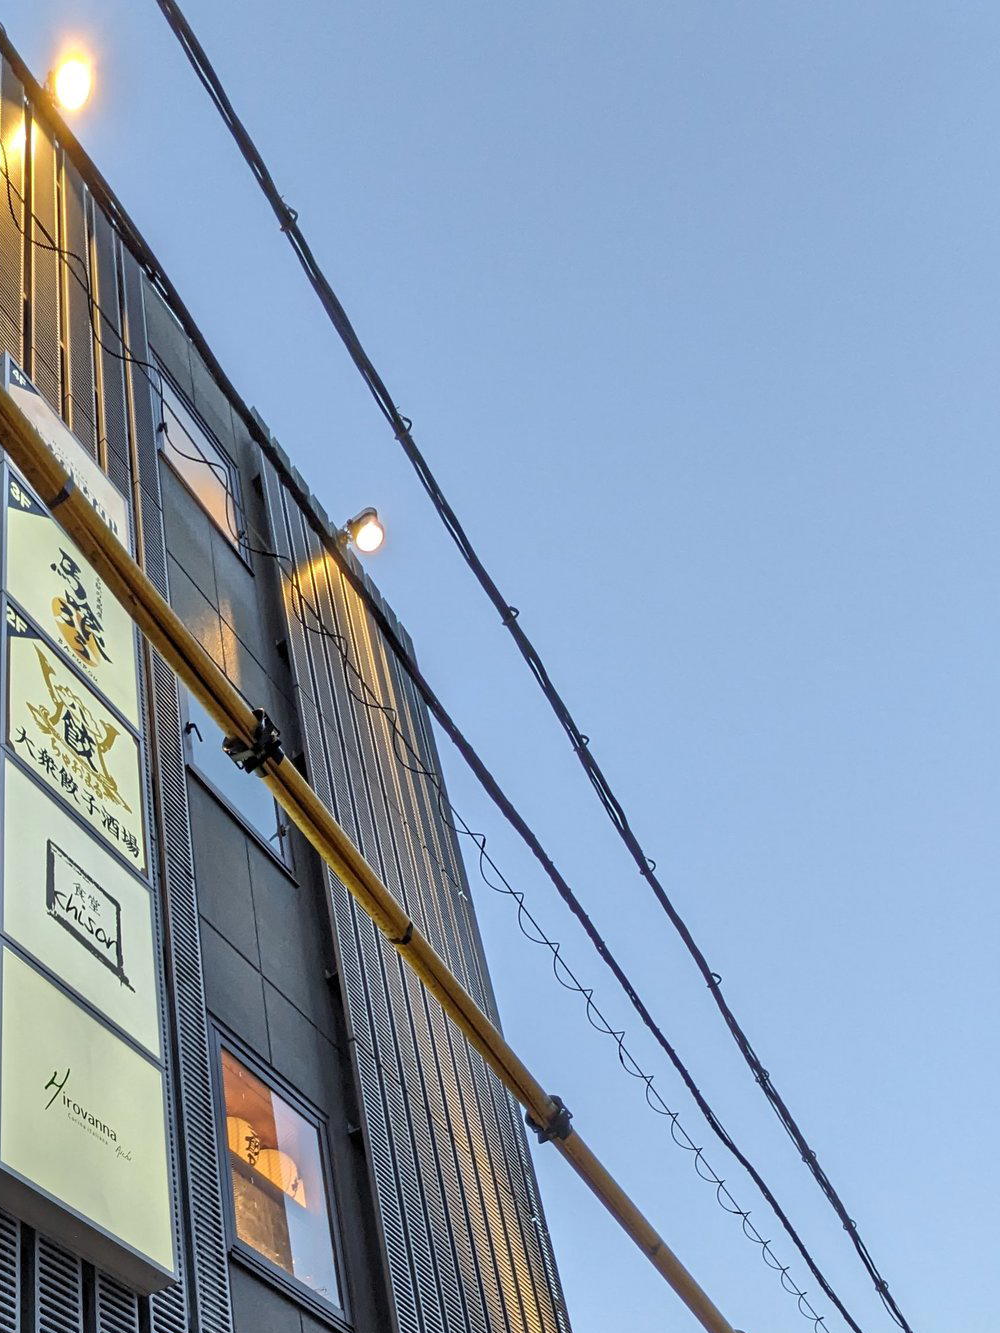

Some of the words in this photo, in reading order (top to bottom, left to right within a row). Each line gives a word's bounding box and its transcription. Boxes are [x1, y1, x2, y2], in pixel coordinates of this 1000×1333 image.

[12, 369, 26, 387] 4F
[10, 481, 31, 509] 3F
[7, 605, 28, 633] 2F
[15, 725, 140, 858] 大衆餃子酒場
[45, 1068, 117, 1142] Hirovanna
